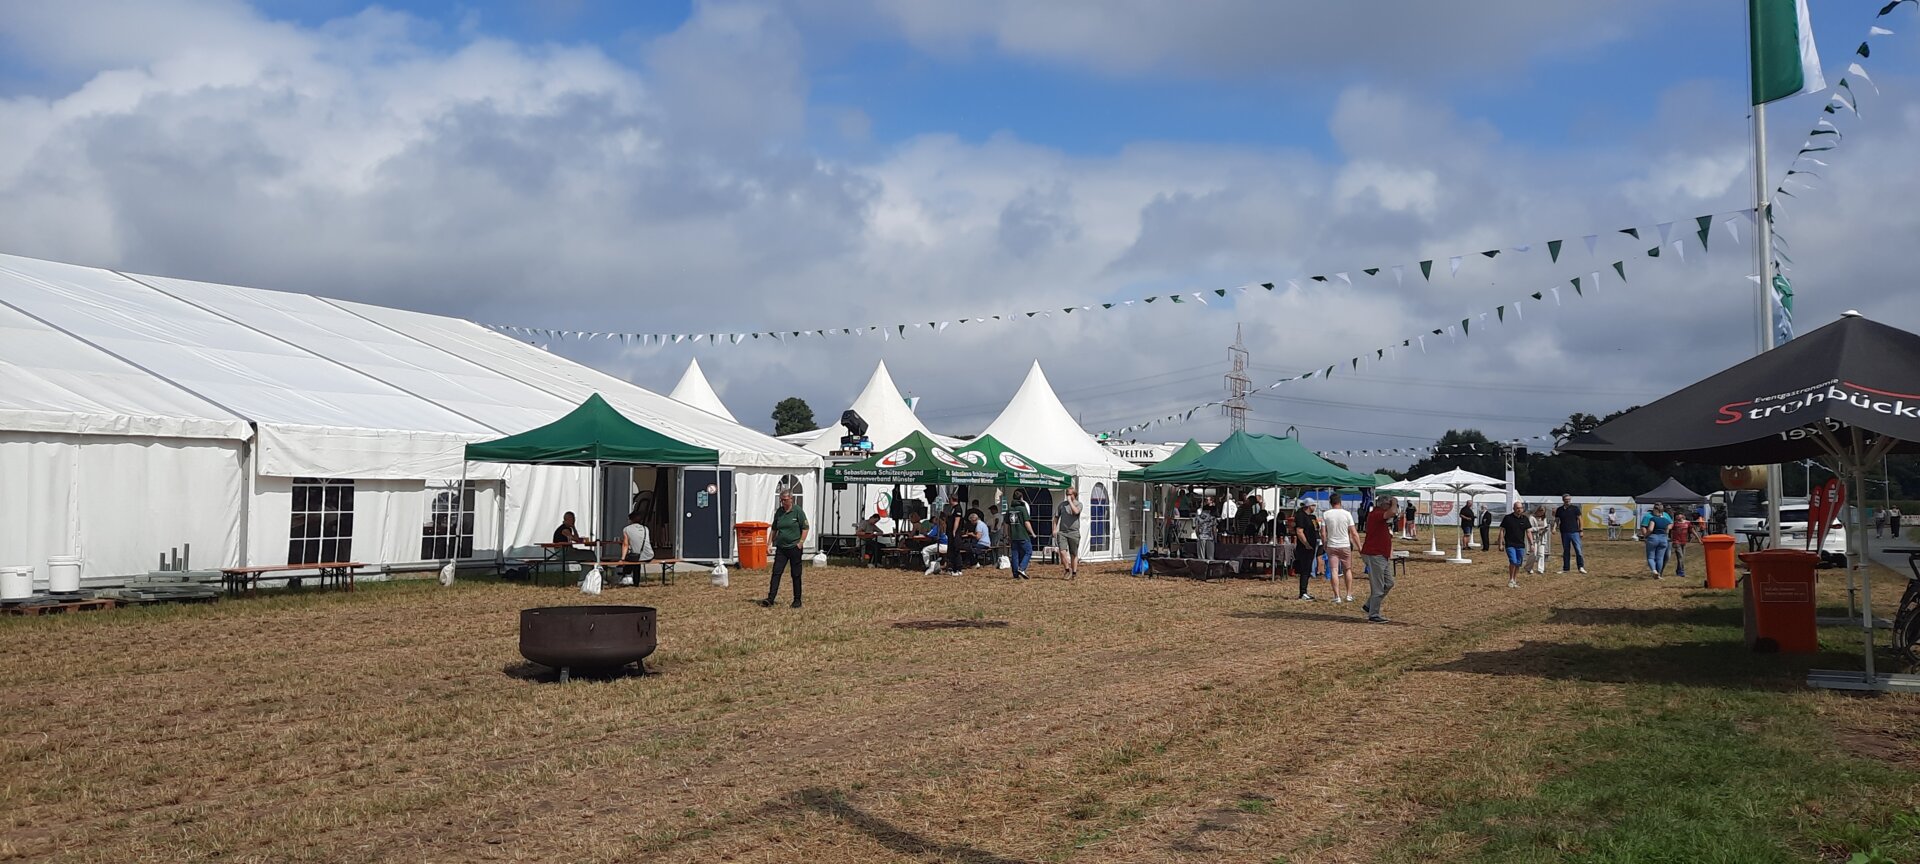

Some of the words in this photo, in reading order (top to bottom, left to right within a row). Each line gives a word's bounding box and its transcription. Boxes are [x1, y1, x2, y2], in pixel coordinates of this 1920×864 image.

[1754, 378, 1839, 403] Eventgastronomie
[1715, 385, 1920, 424] Strohbück
[1119, 450, 1154, 458] VELTINS
